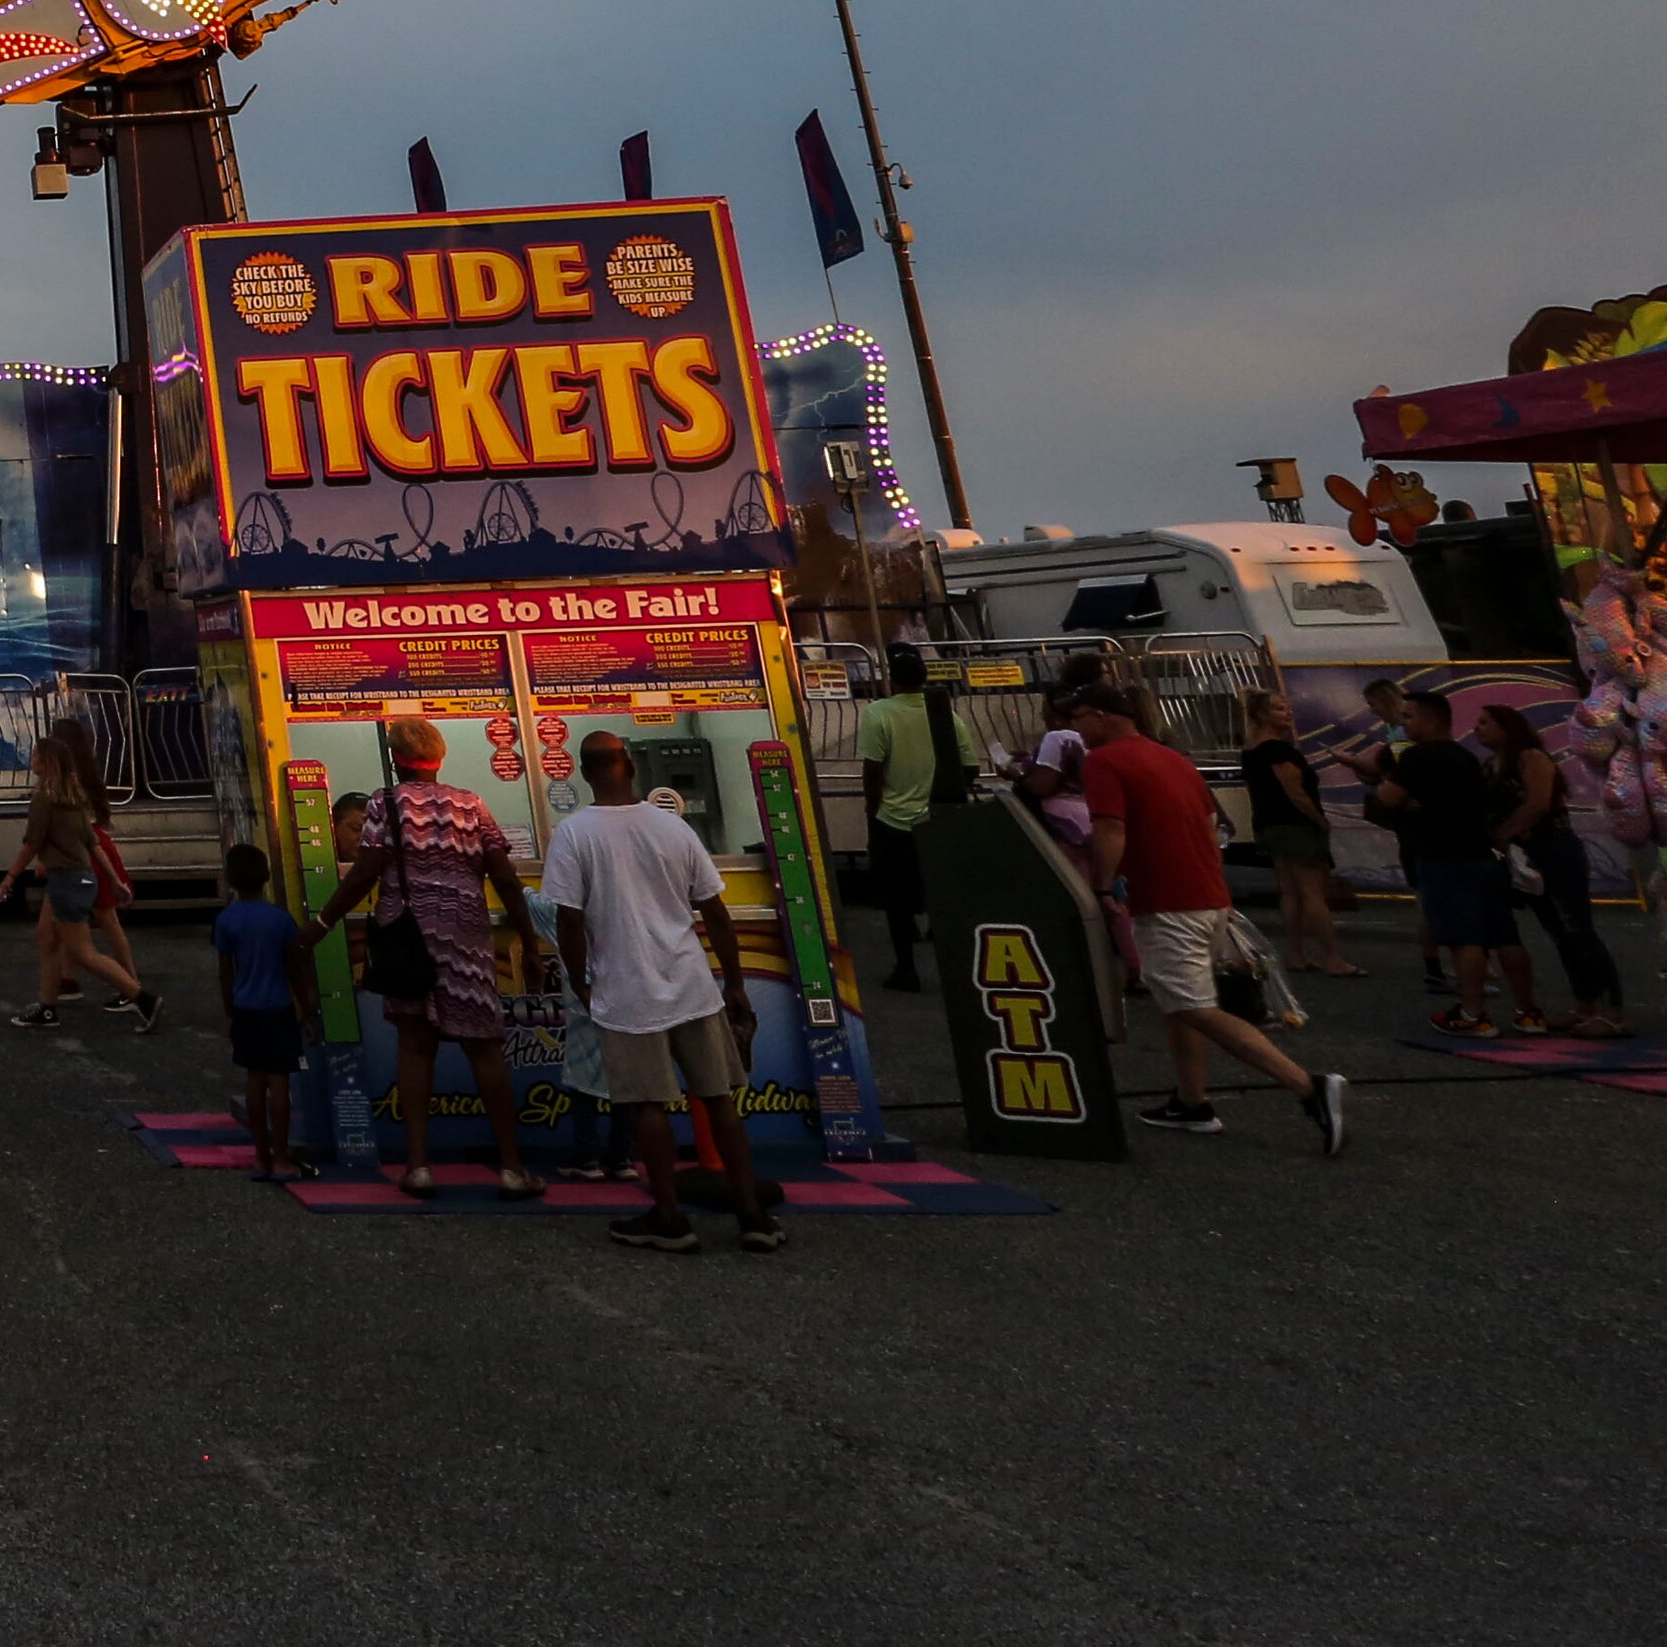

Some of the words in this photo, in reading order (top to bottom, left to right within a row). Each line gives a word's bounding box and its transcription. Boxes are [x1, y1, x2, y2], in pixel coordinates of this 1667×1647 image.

[616, 244, 677, 259] PARENTS
[235, 266, 277, 281] CHECK
[279, 264, 305, 278] THE
[606, 262, 623, 275] BE
[627, 260, 656, 273] SIZE
[659, 257, 694, 272] WISE
[233, 281, 257, 296] SKY
[262, 279, 311, 294] BEFORE
[327, 244, 592, 328] RIDE
[613, 279, 642, 289] MAKE
[645, 277, 670, 287] SURE
[672, 276, 693, 286] THE
[245, 296, 271, 310] YOU
[276, 294, 303, 309] BUY
[618, 293, 642, 304] KIDS
[645, 291, 694, 302] MEASURE
[245, 313, 260, 325] NO
[263, 311, 308, 324] REFUNDS
[650, 307, 666, 318] UP
[239, 337, 730, 480] TICKETS
[303, 599, 489, 630] Welcome
[497, 597, 541, 623] to
[551, 593, 617, 621] the
[625, 588, 720, 619] Fair!
[559, 635, 597, 643] NOTICE
[645, 631, 694, 643] CREDIT
[700, 630, 748, 642] PRICES
[399, 640, 447, 652] CREDIT
[452, 639, 500, 651] PRICES
[350, 691, 362, 699] FOR
[534, 685, 556, 694] PLEASE
[597, 683, 610, 691] FOR
[287, 767, 326, 775] MEASURE
[297, 775, 317, 783] HERE
[975, 925, 1085, 1121] ATM
